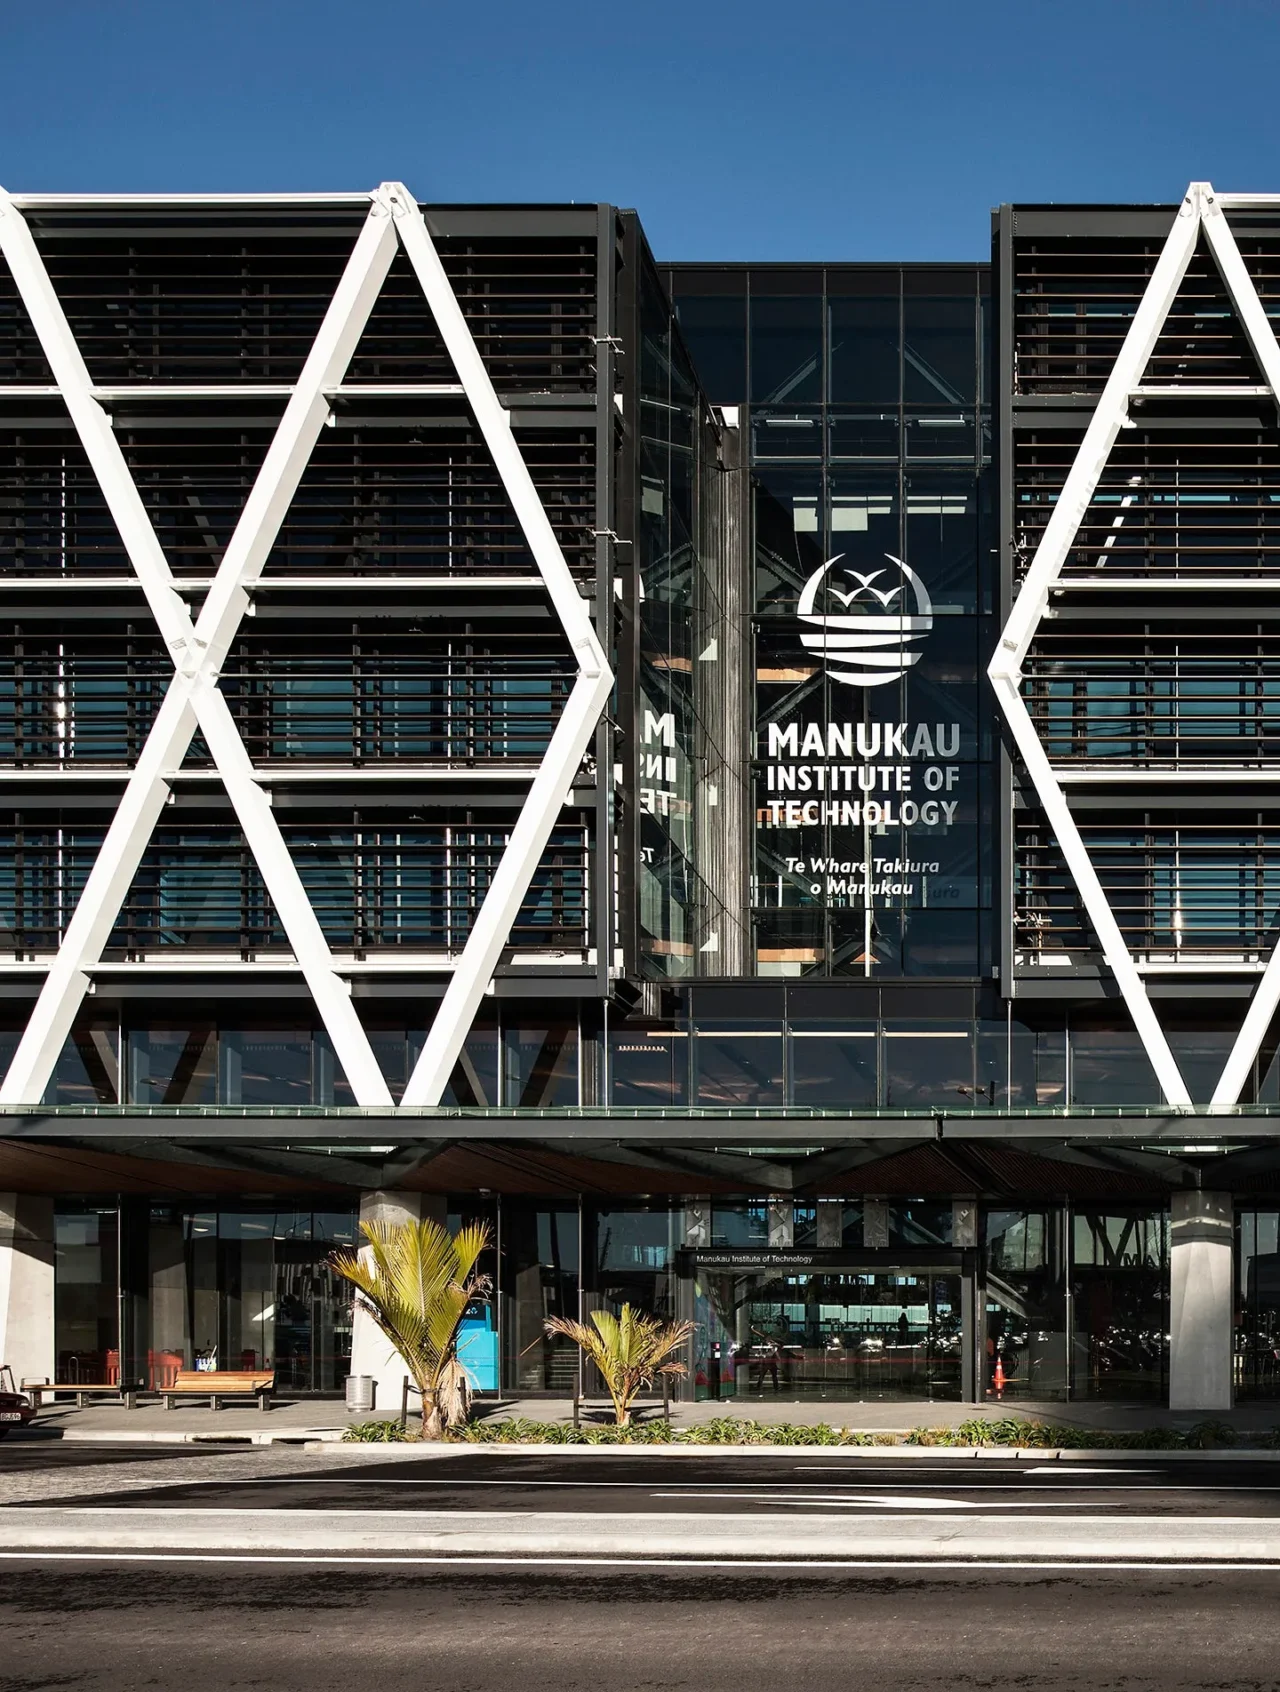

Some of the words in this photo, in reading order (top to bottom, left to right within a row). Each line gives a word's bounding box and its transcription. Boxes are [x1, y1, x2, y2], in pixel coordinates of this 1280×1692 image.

[768, 722, 960, 757] MANUKAU
[767, 765, 912, 791] INSTITUTE
[924, 766, 960, 791] OF
[767, 800, 959, 826] TECHNOLOGY
[785, 857, 806, 873] Te
[810, 857, 868, 873] Whare
[873, 857, 940, 873] Takiura
[810, 883, 822, 895] o
[827, 879, 914, 895] Manukau
[696, 1255, 730, 1263] Manukau
[731, 1255, 760, 1263] Institute
[762, 1255, 771, 1263] of
[771, 1255, 812, 1264] Technology
